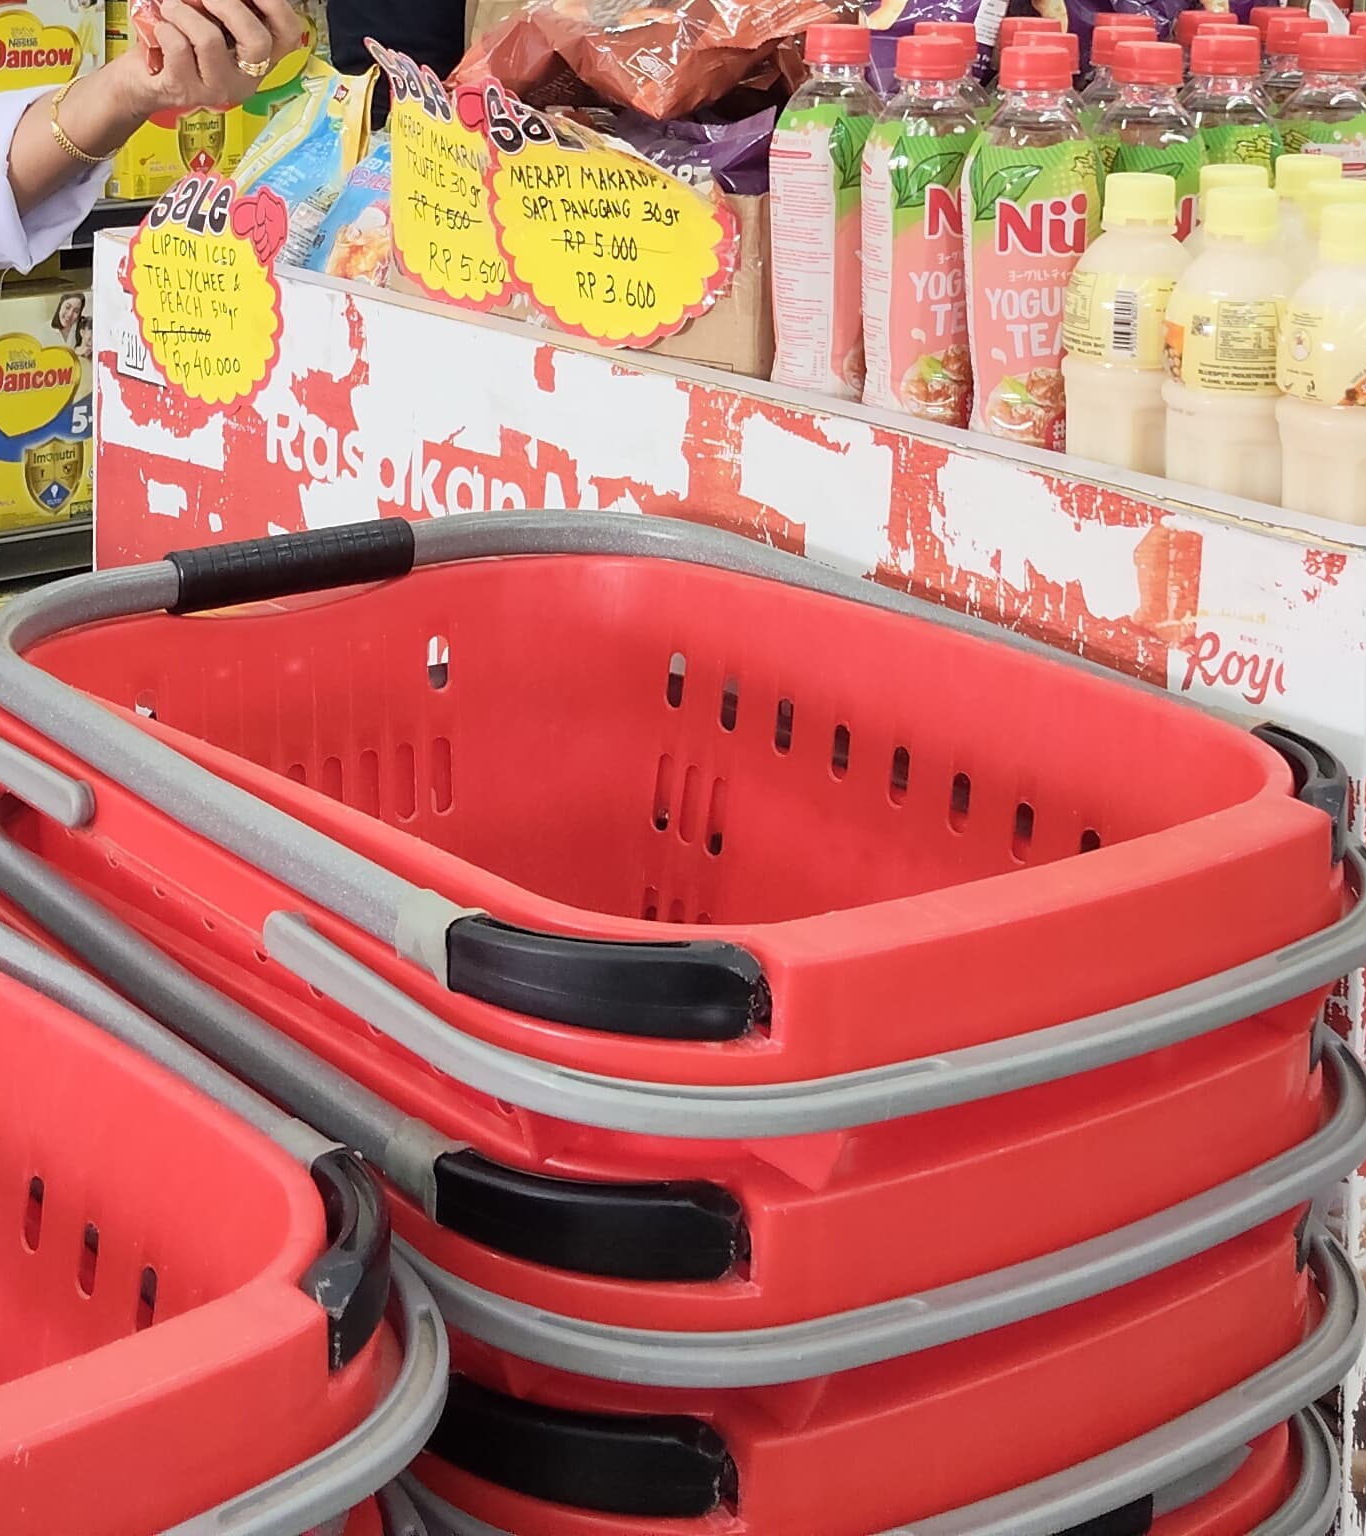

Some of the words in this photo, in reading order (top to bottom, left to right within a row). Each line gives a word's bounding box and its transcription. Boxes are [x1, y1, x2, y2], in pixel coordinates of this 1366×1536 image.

[406, 145, 446, 189] TRUFFLE
[510, 166, 571, 191] MERAPI
[522, 197, 554, 221] SAPI
[560, 200, 631, 222] PANGGANG
[152, 233, 196, 261] LIPTON
[206, 246, 236, 266] ICED
[564, 230, 586, 255] RP
[593, 232, 638, 261] 5.000
[143, 264, 171, 289] TEA
[178, 268, 225, 293] LYCHEE
[429, 243, 450, 283] RP
[461, 256, 506, 284] 5.500
[160, 291, 202, 317] PEACH
[576, 271, 597, 300] RP
[603, 274, 656, 309] 3.600
[153, 318, 168, 358] Rp
[173, 351, 190, 388] Rp
[194, 350, 241, 380] 40.000
